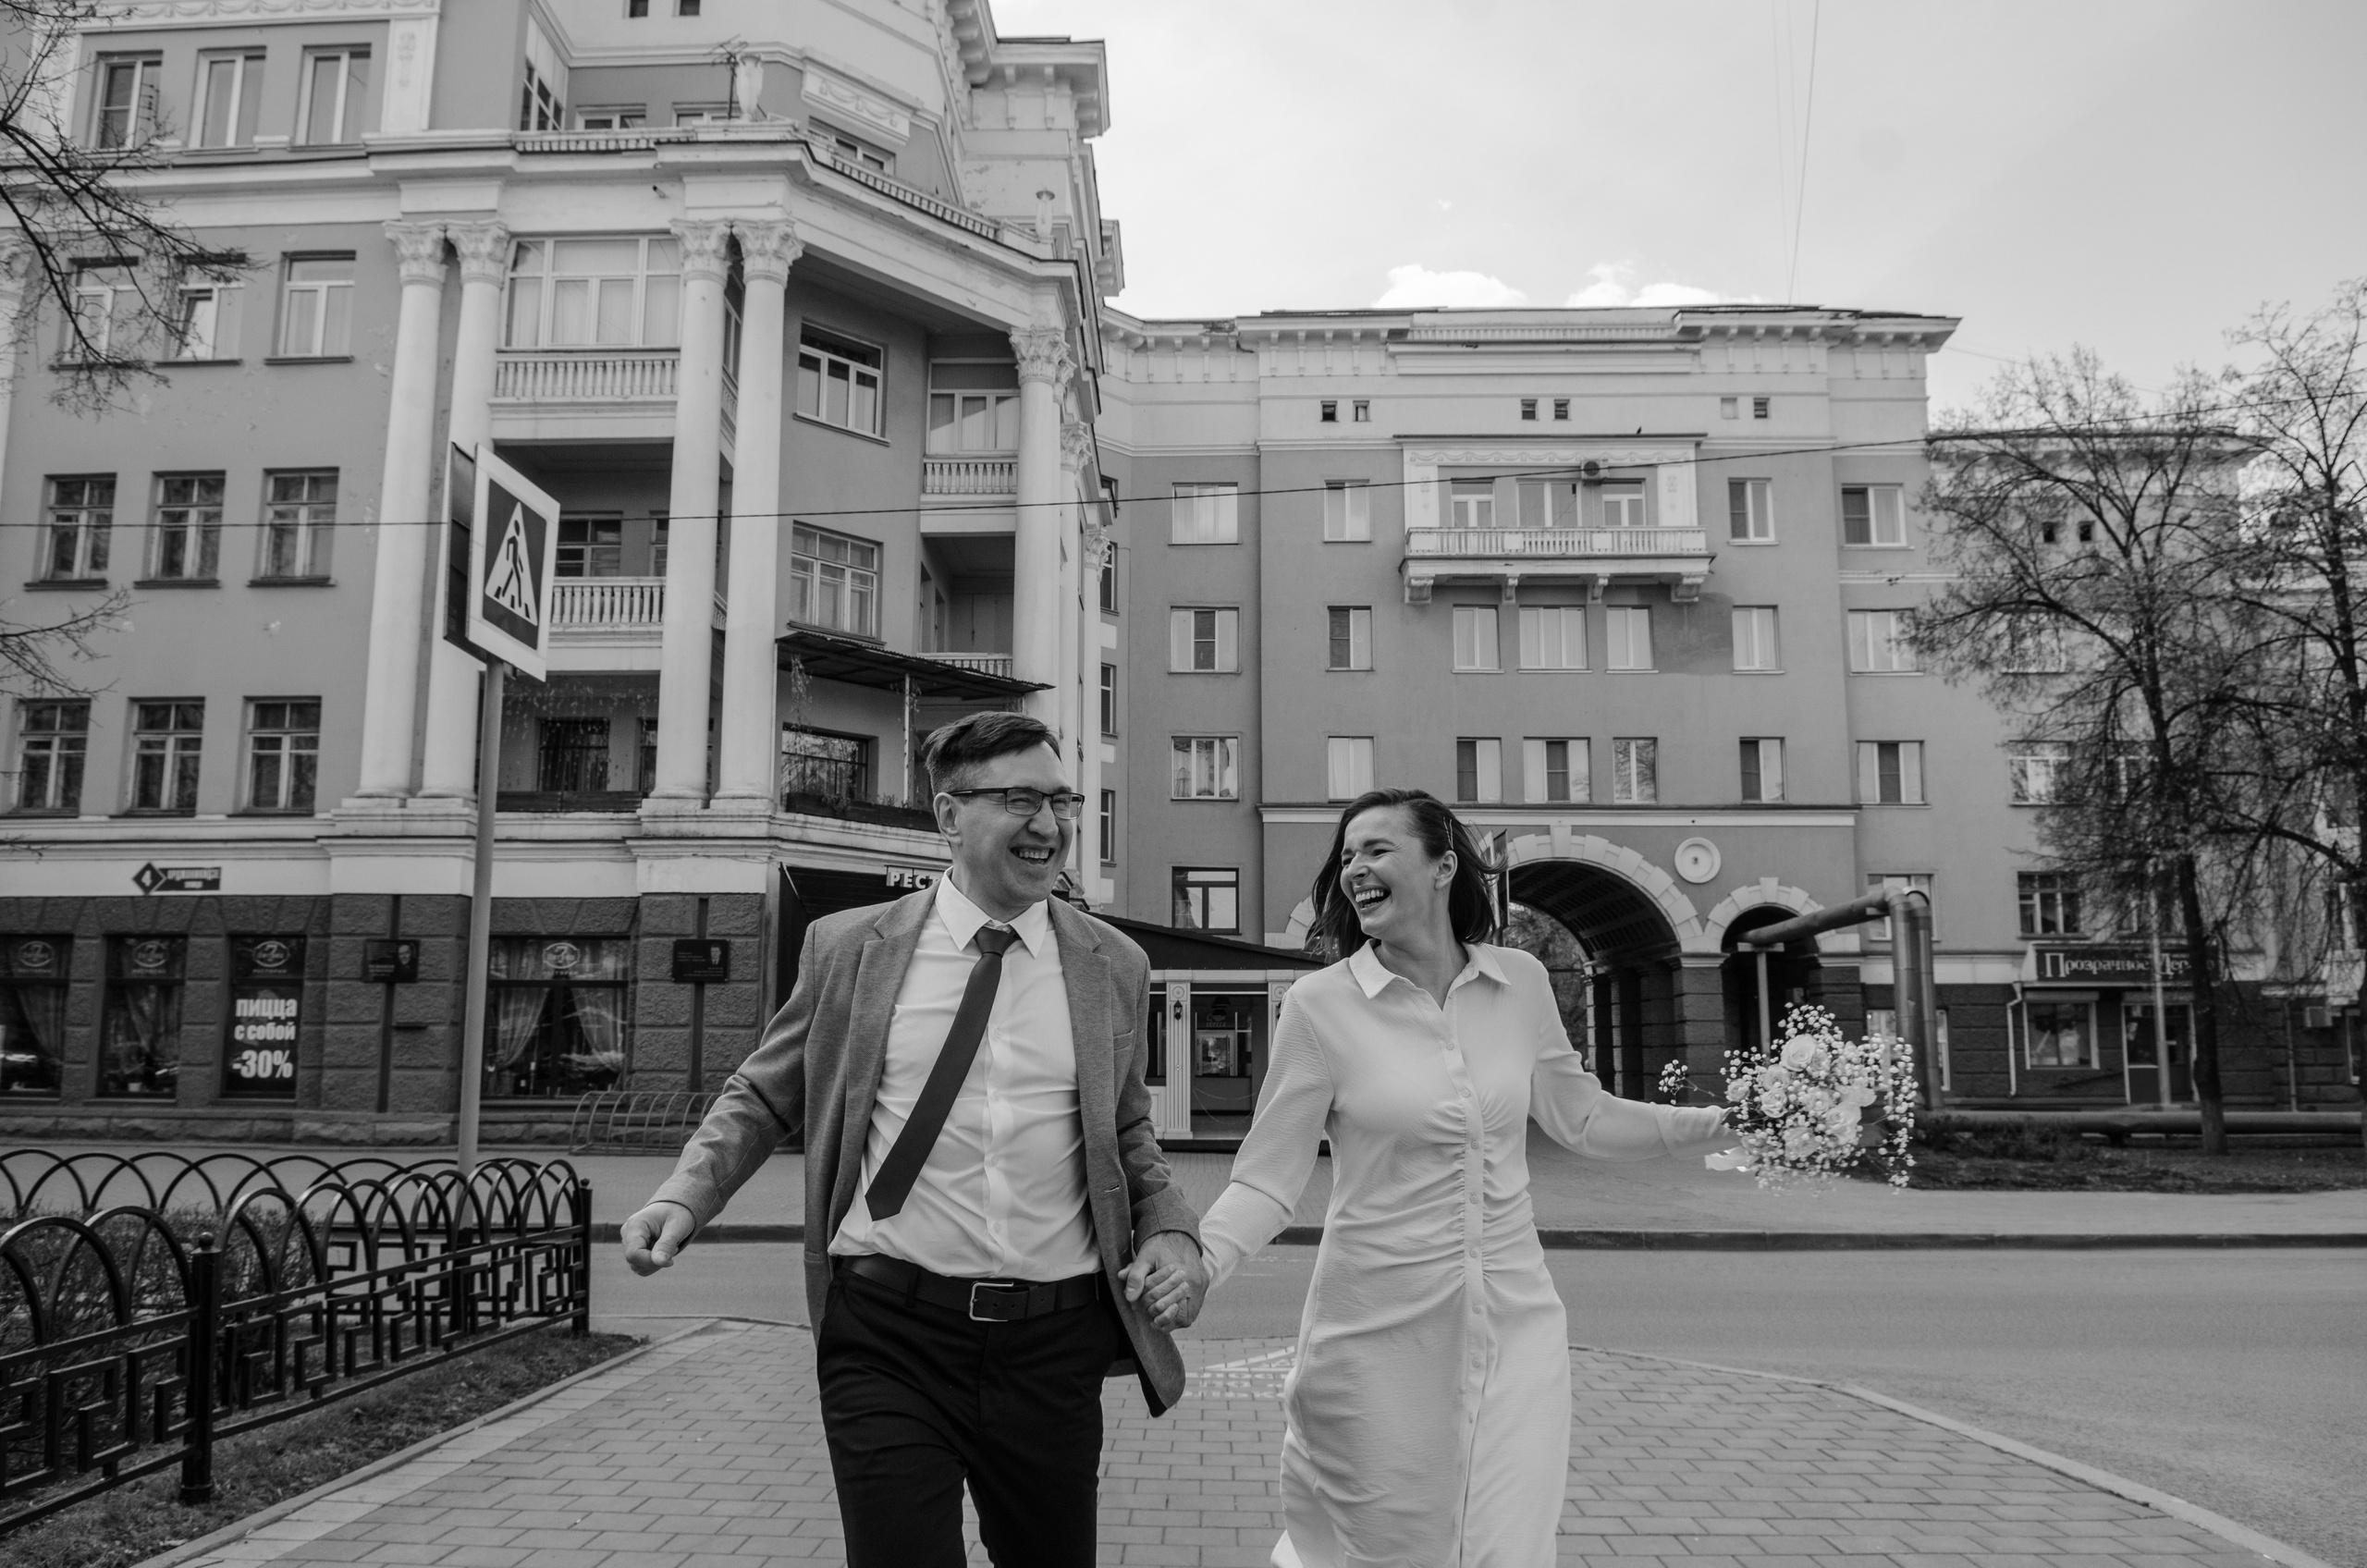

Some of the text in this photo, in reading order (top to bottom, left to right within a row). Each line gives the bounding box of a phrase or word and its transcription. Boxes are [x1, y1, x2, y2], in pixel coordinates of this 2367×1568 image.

[141, 869, 153, 887] 4
[235, 998, 298, 1020] пицца
[234, 1022, 297, 1041] с собой
[231, 1049, 294, 1079] -30%
